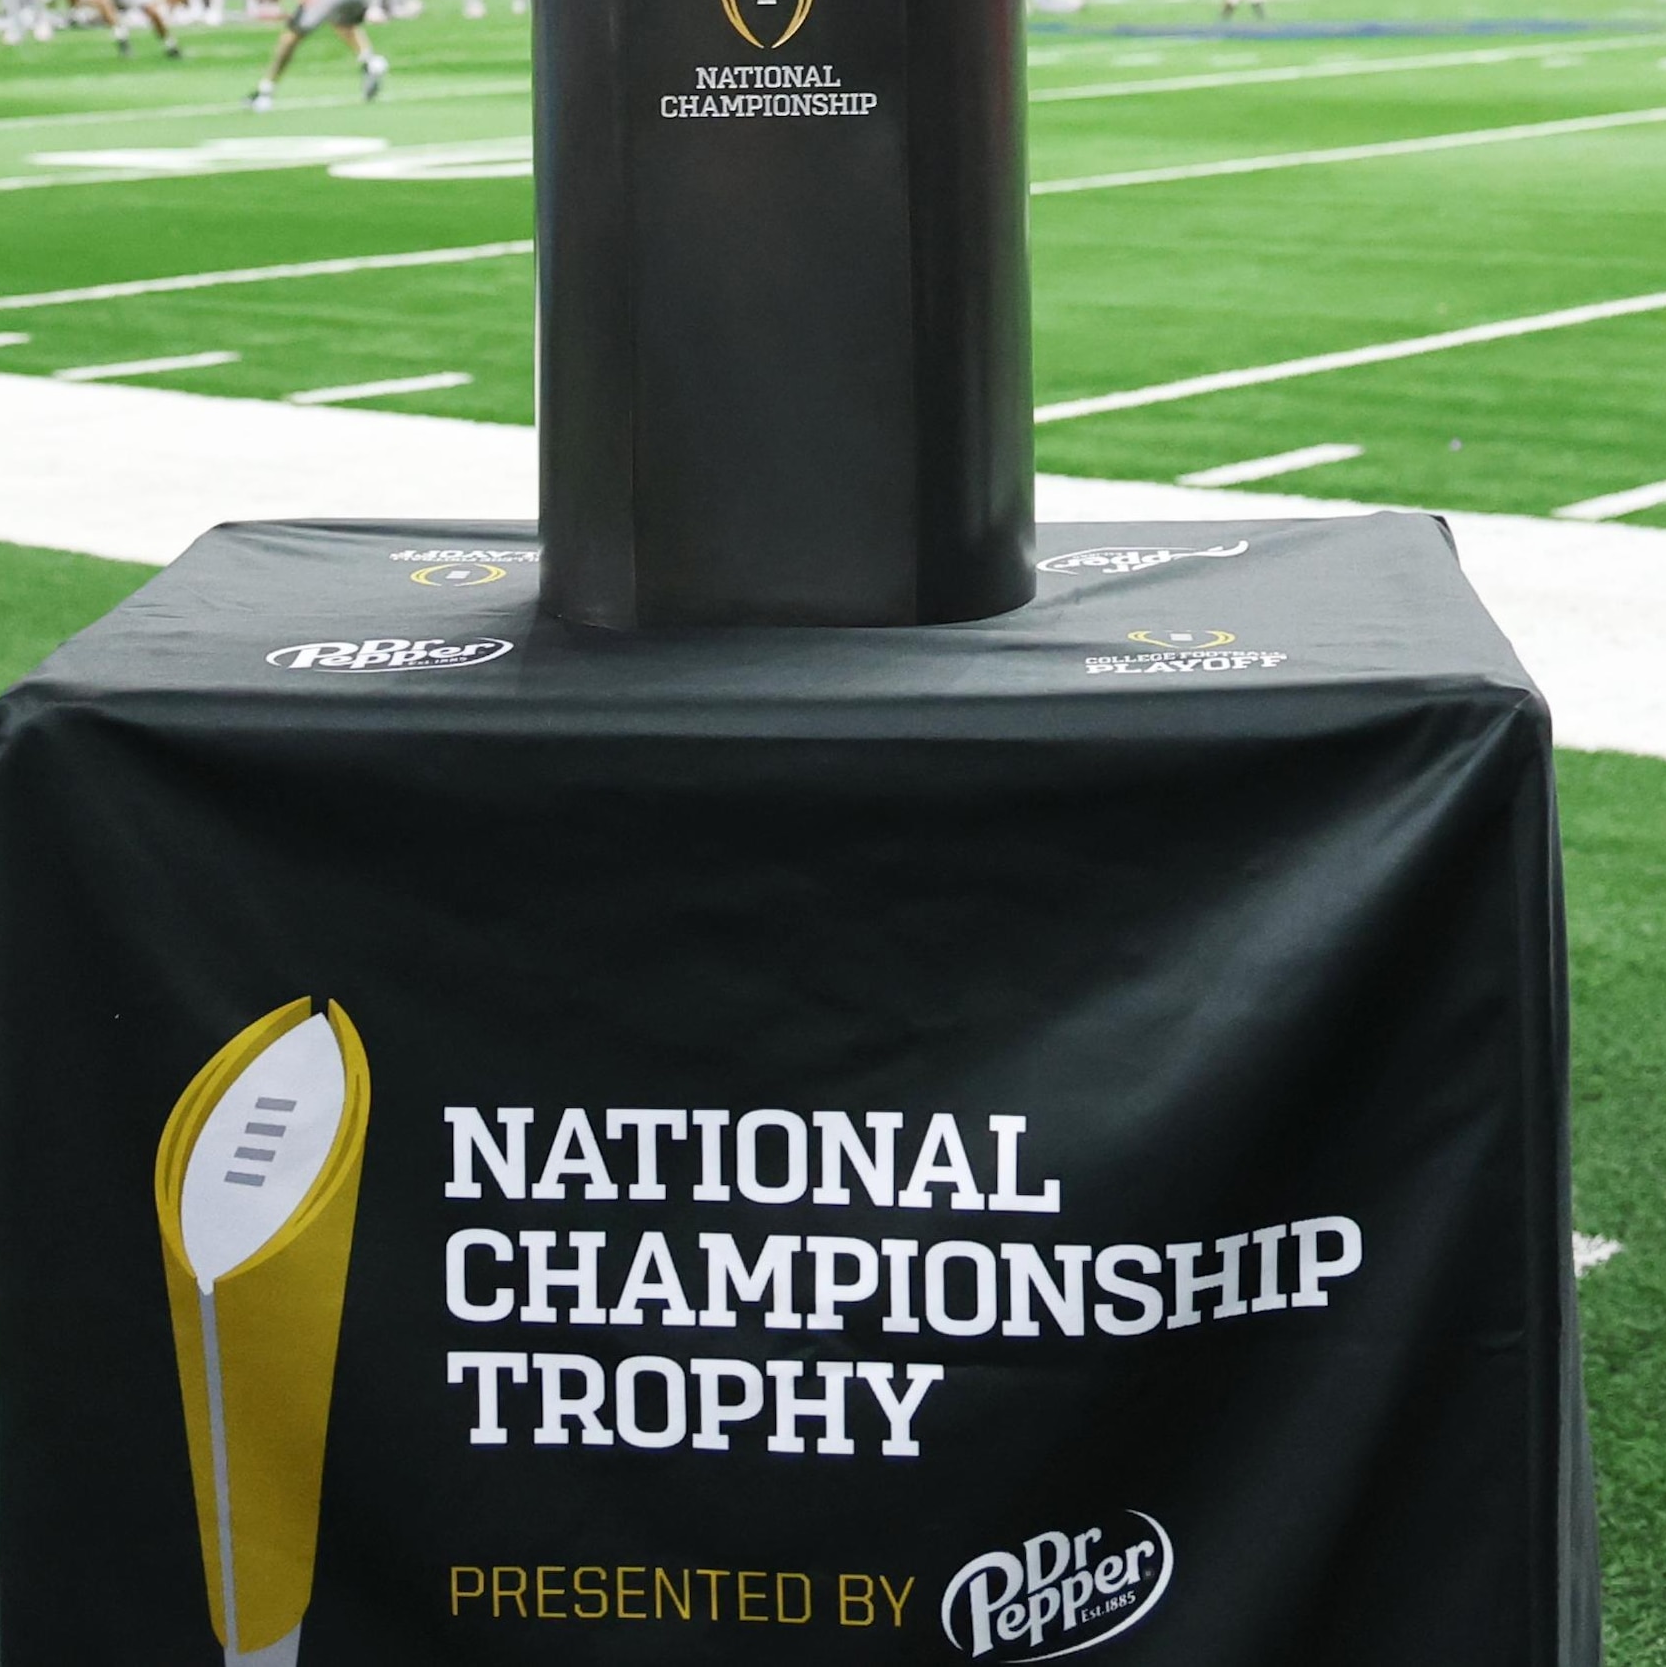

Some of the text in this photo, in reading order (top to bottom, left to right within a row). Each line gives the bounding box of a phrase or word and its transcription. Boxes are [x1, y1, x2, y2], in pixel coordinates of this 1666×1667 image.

[696, 65, 841, 90] NATIONAL
[660, 93, 878, 118] CHAMPIONSHIP
[278, 641, 497, 670] Pepper
[357, 638, 446, 656] Dr
[1084, 652, 1177, 666] COLLEGE
[1085, 655, 1288, 675] PLAYOFF
[444, 1106, 1061, 1213] NATIONAL
[444, 1215, 1363, 1337] CHAMPIONSHIP
[446, 1351, 944, 1457] TROPHY
[1023, 1527, 1102, 1595] Dr
[450, 1565, 916, 1628] PRESENTED BY
[941, 1540, 1155, 1658] Pepper
